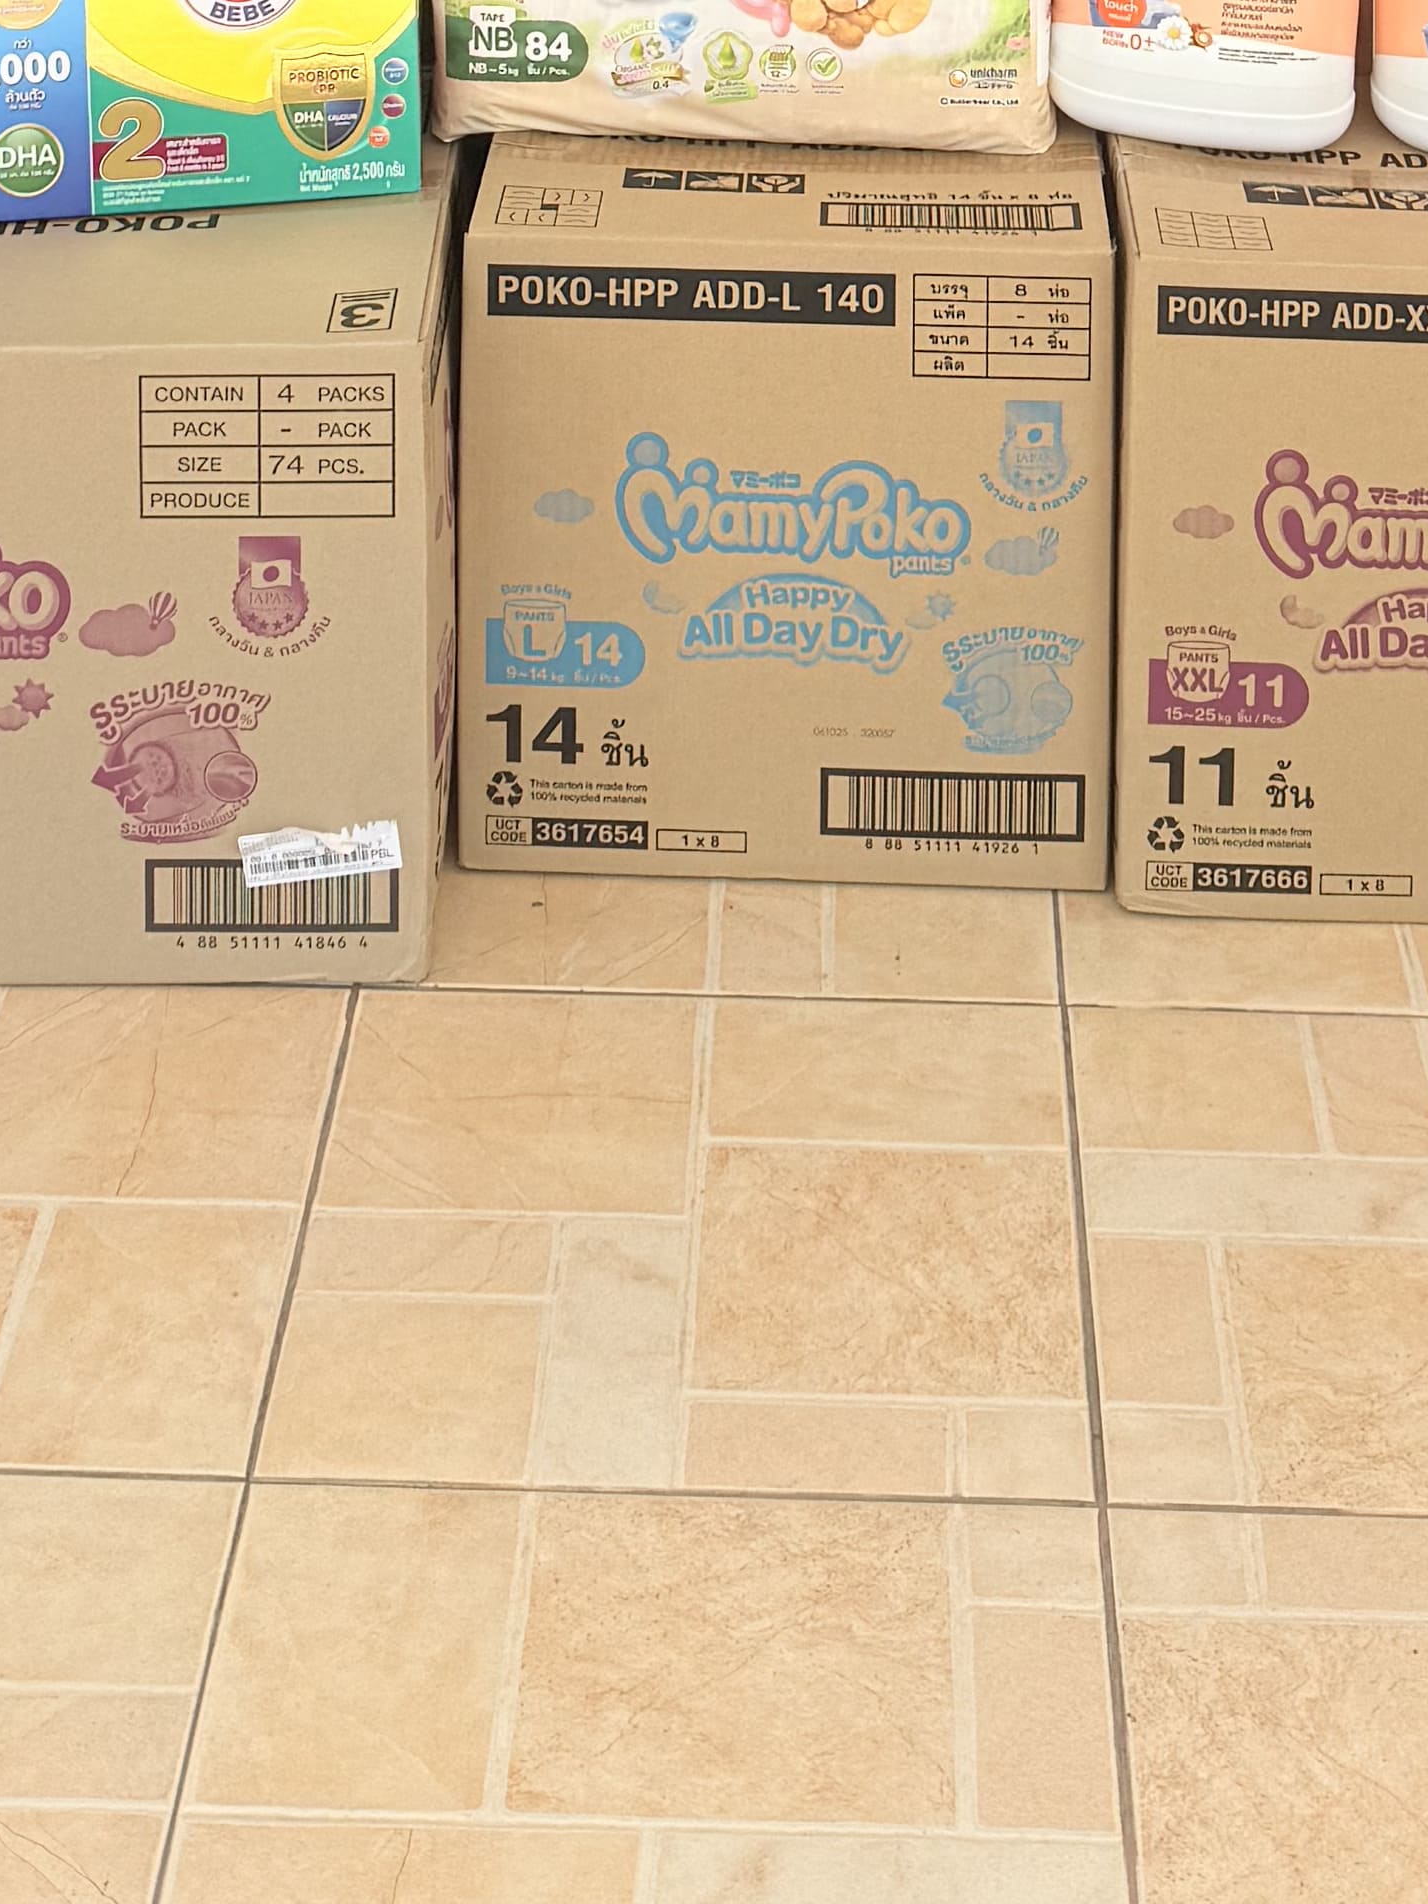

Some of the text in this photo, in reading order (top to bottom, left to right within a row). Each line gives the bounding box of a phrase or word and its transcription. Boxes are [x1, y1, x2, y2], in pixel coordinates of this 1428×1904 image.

[473, 24, 573, 62] NB 84
[352, 163, 384, 183] 2,500
[497, 275, 885, 314] POKO-HPP ADD-L 140
[1167, 298, 1321, 330] POKO-HPP
[154, 385, 385, 404] CONTAIN 4 PACKS
[172, 421, 372, 438] PACK PACK
[177, 454, 365, 475] SIZE 74 PCS.
[150, 492, 251, 509] PRODUCE
[615, 432, 971, 564] MamyPoko
[683, 614, 903, 662] All Day Dry
[1171, 667, 1225, 693] XXL
[485, 703, 650, 768] 14 ชิ้น
[535, 821, 645, 846] 3617654
[971, 840, 1020, 855] 41926
[1197, 866, 1309, 891] 3617666
[229, 936, 348, 951] 51111 41846
